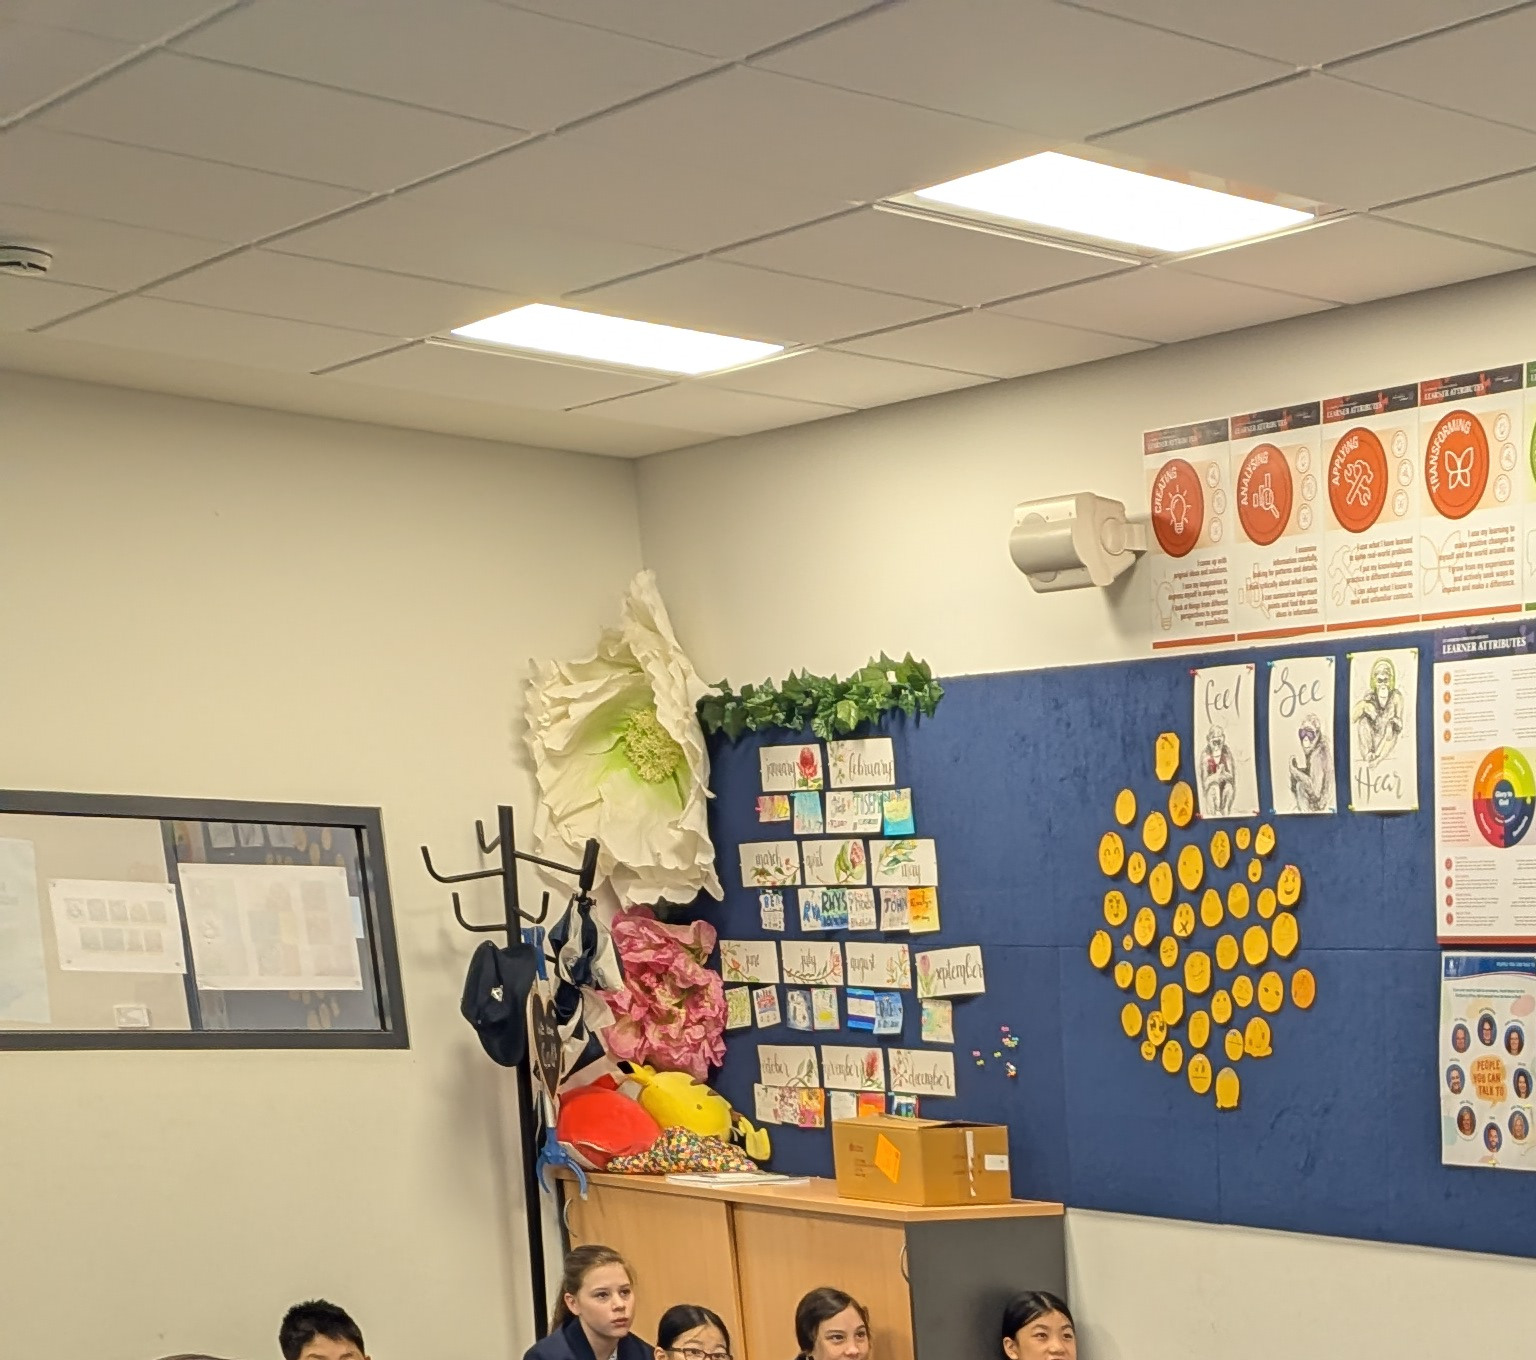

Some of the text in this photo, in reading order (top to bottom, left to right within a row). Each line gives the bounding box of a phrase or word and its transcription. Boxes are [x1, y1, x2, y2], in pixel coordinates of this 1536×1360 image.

[1331, 435, 1360, 486] APPLYING
[1429, 418, 1472, 493] TRANSFORMING
[1442, 641, 1477, 654] LEARNER
[1478, 636, 1527, 651] ATTRIBUTES
[1274, 667, 1325, 718] See
[849, 751, 893, 783] february
[1355, 766, 1404, 805] Hear
[823, 891, 849, 914] RHYS
